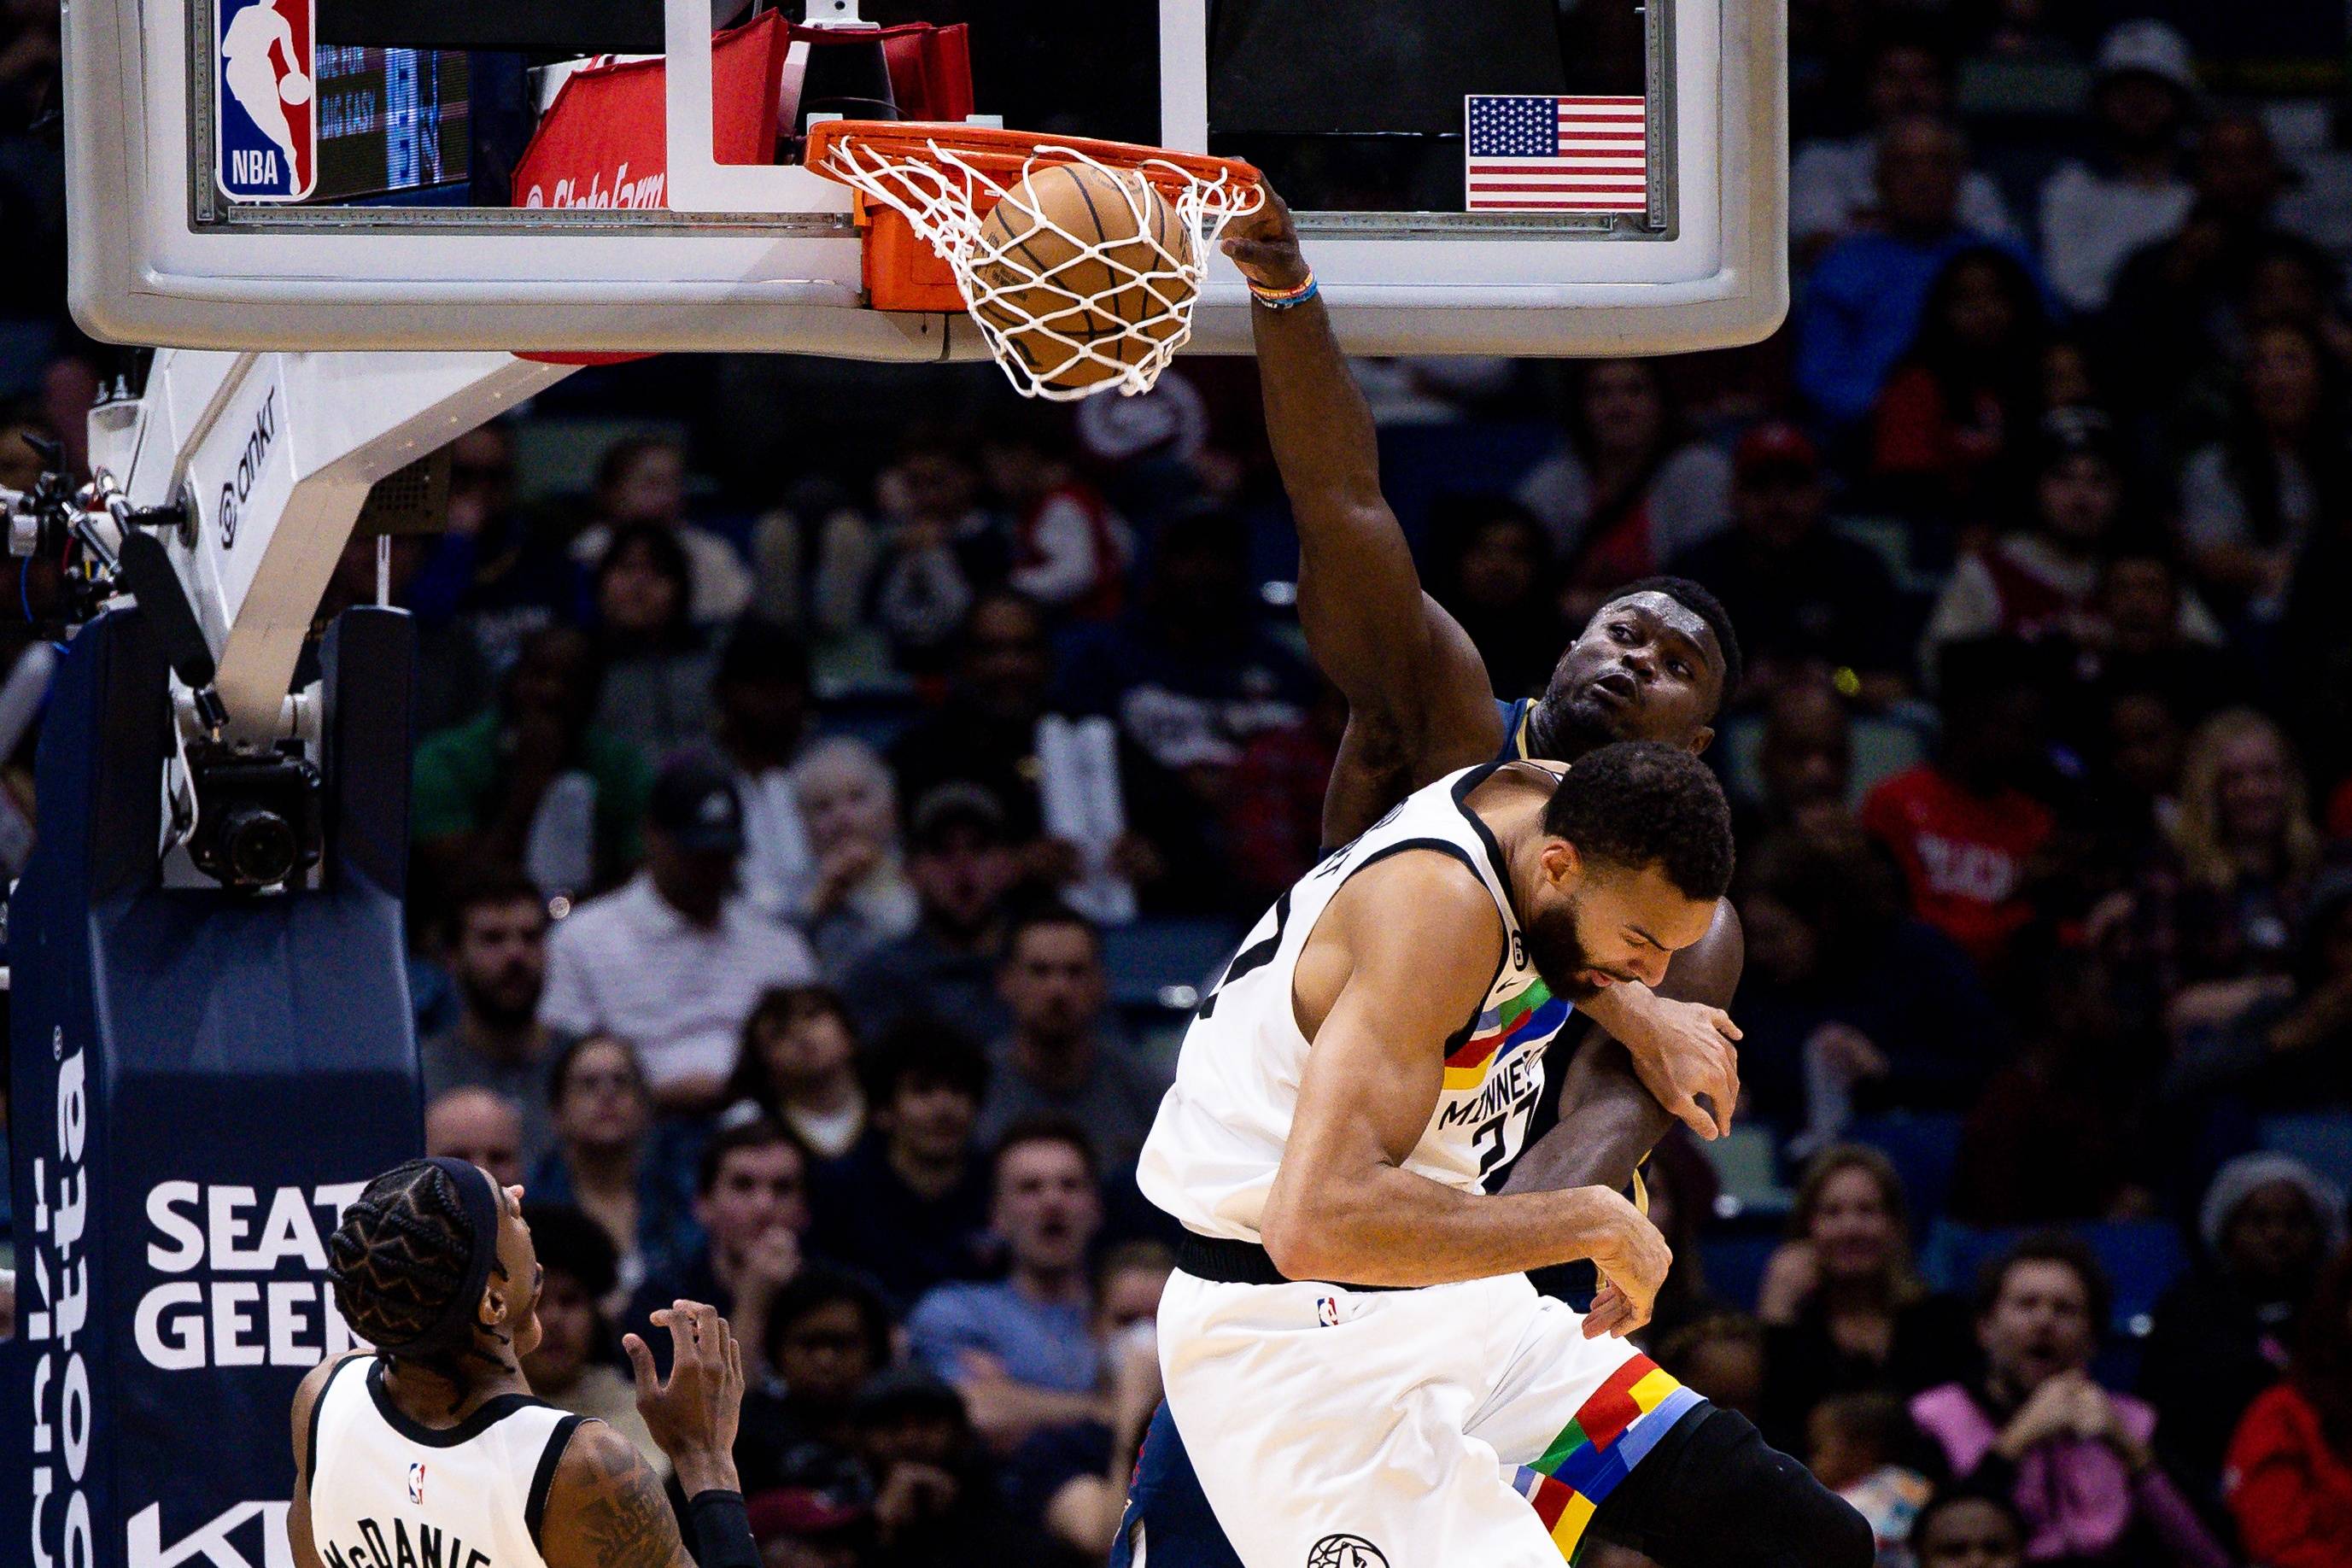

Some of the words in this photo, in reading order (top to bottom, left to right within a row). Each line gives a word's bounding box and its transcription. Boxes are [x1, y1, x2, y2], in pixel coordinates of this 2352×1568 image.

[231, 149, 278, 184] NBA
[237, 384, 274, 504] ankr
[1512, 936, 1524, 967] 6
